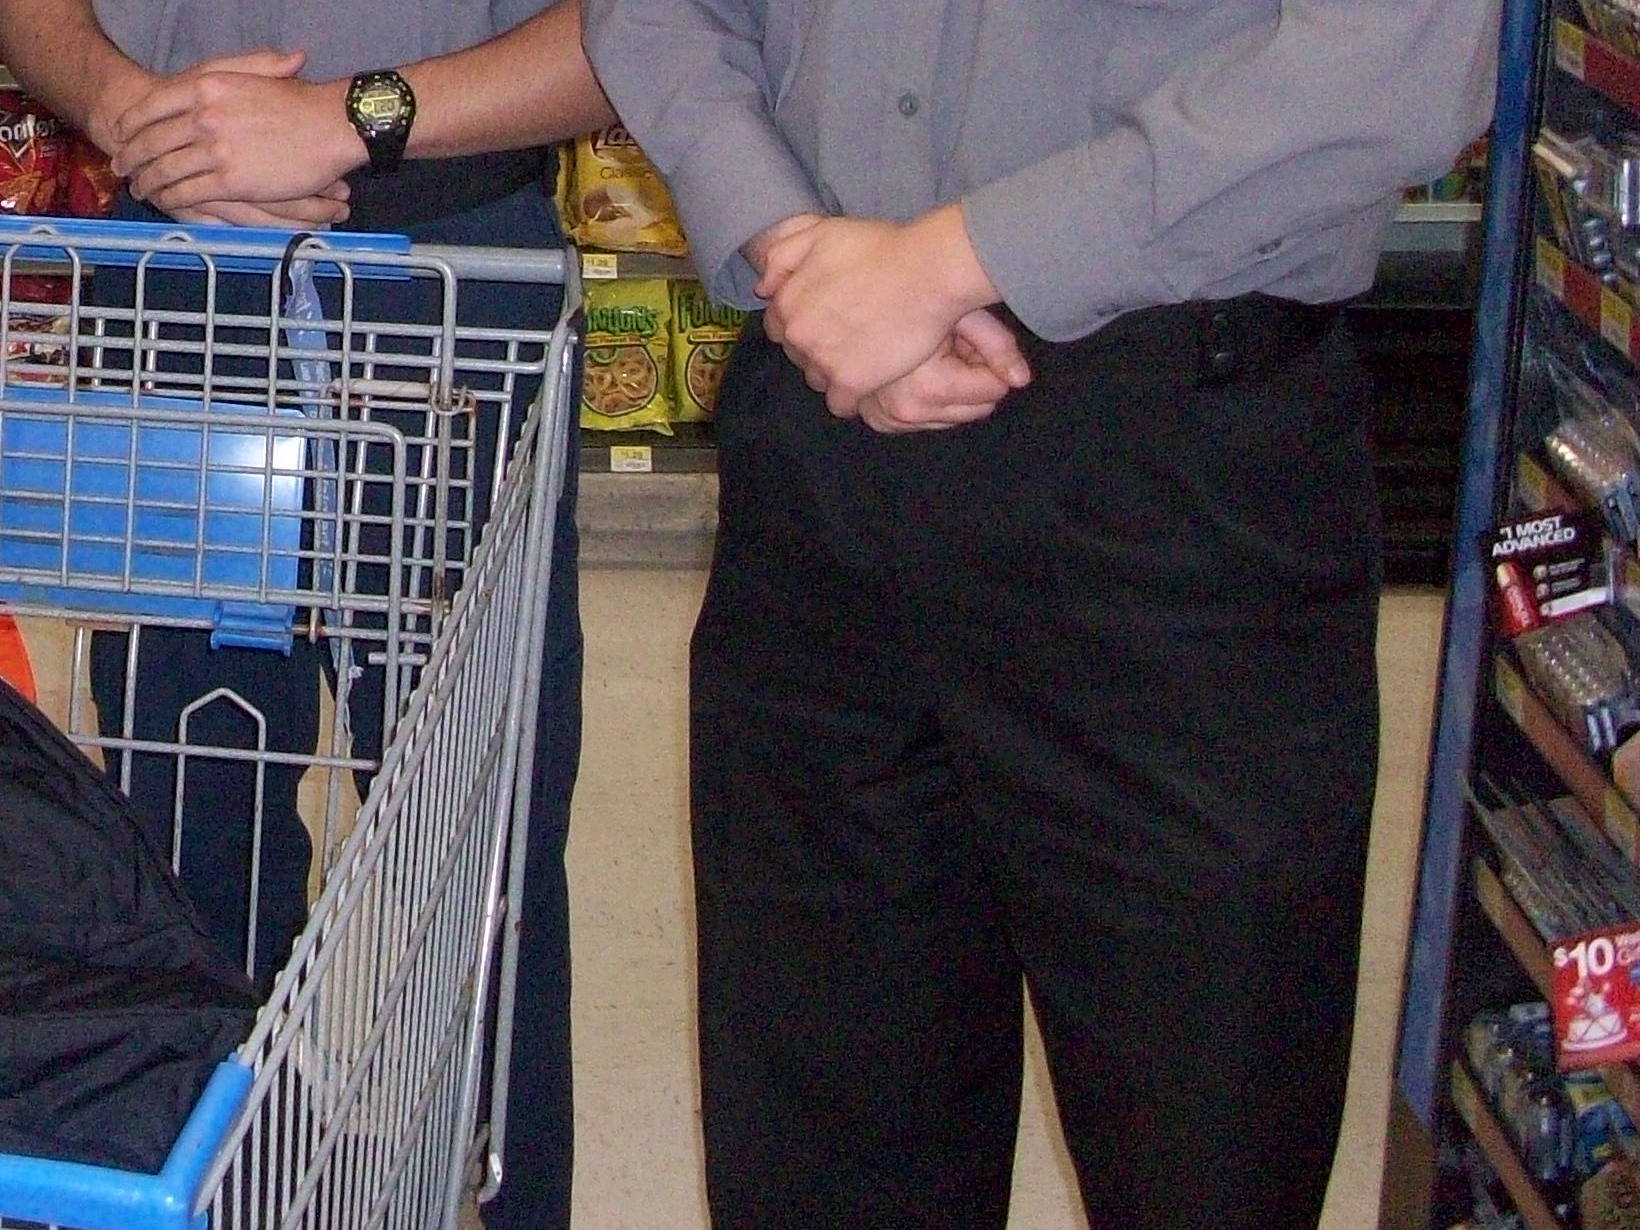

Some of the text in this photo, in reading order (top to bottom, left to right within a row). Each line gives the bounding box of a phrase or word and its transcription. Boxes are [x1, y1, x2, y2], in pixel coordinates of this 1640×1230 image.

[1515, 515, 1562, 538] MOST
[1492, 527, 1575, 557] ADVANCED
[1553, 937, 1615, 977] $10
